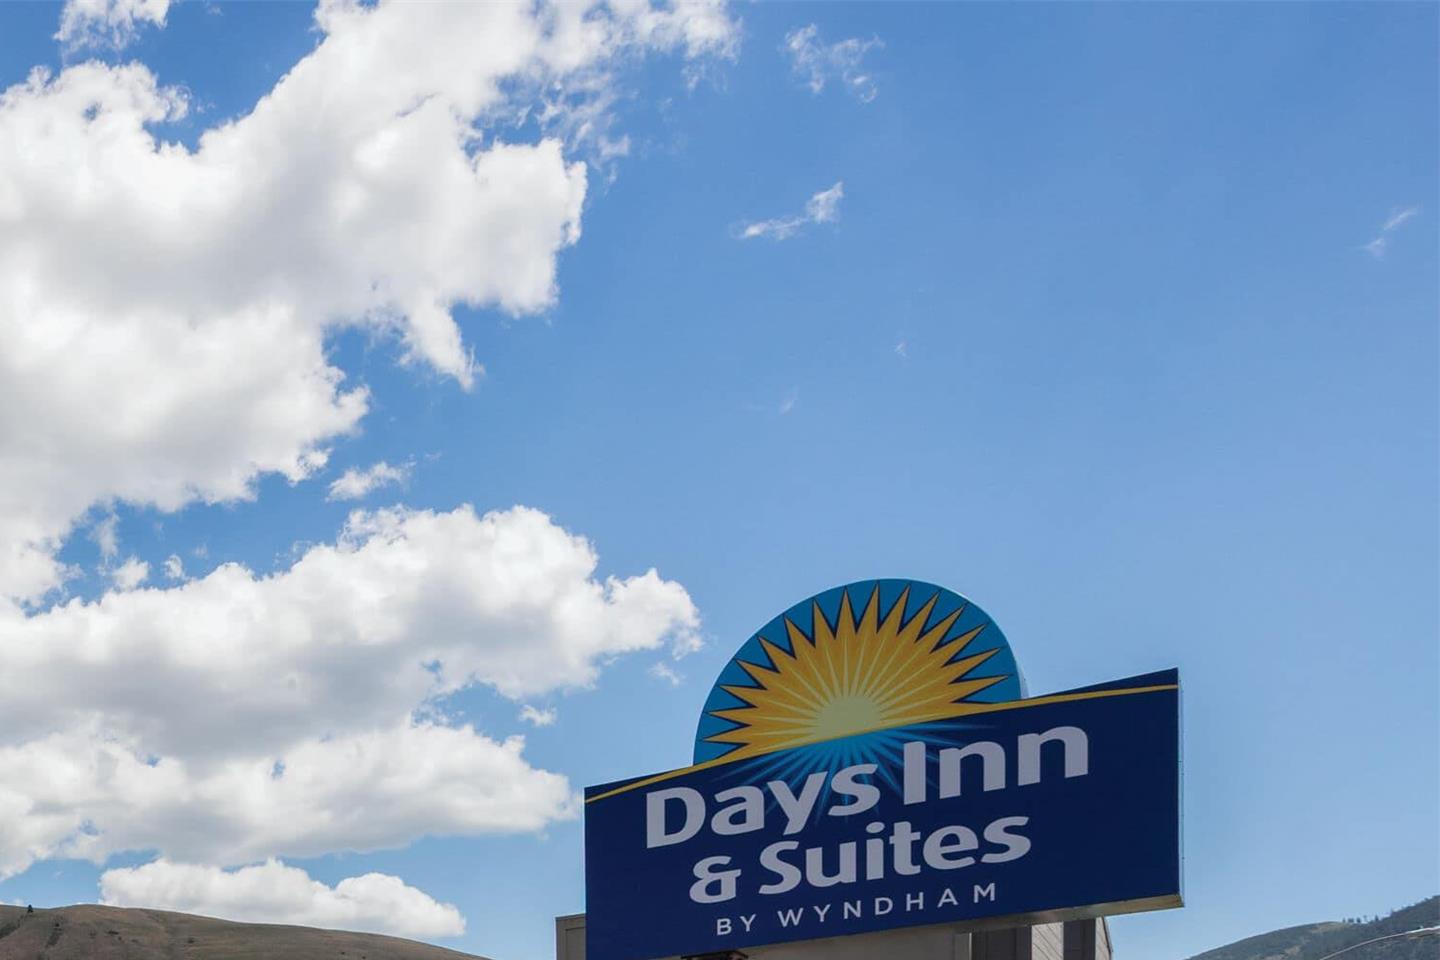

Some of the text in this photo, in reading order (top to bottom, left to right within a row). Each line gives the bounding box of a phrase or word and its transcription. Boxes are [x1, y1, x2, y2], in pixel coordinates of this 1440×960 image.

[646, 725, 1089, 849] Days Inn
[689, 815, 1032, 904] & Suites
[716, 882, 997, 935] BY WYNDHAM
